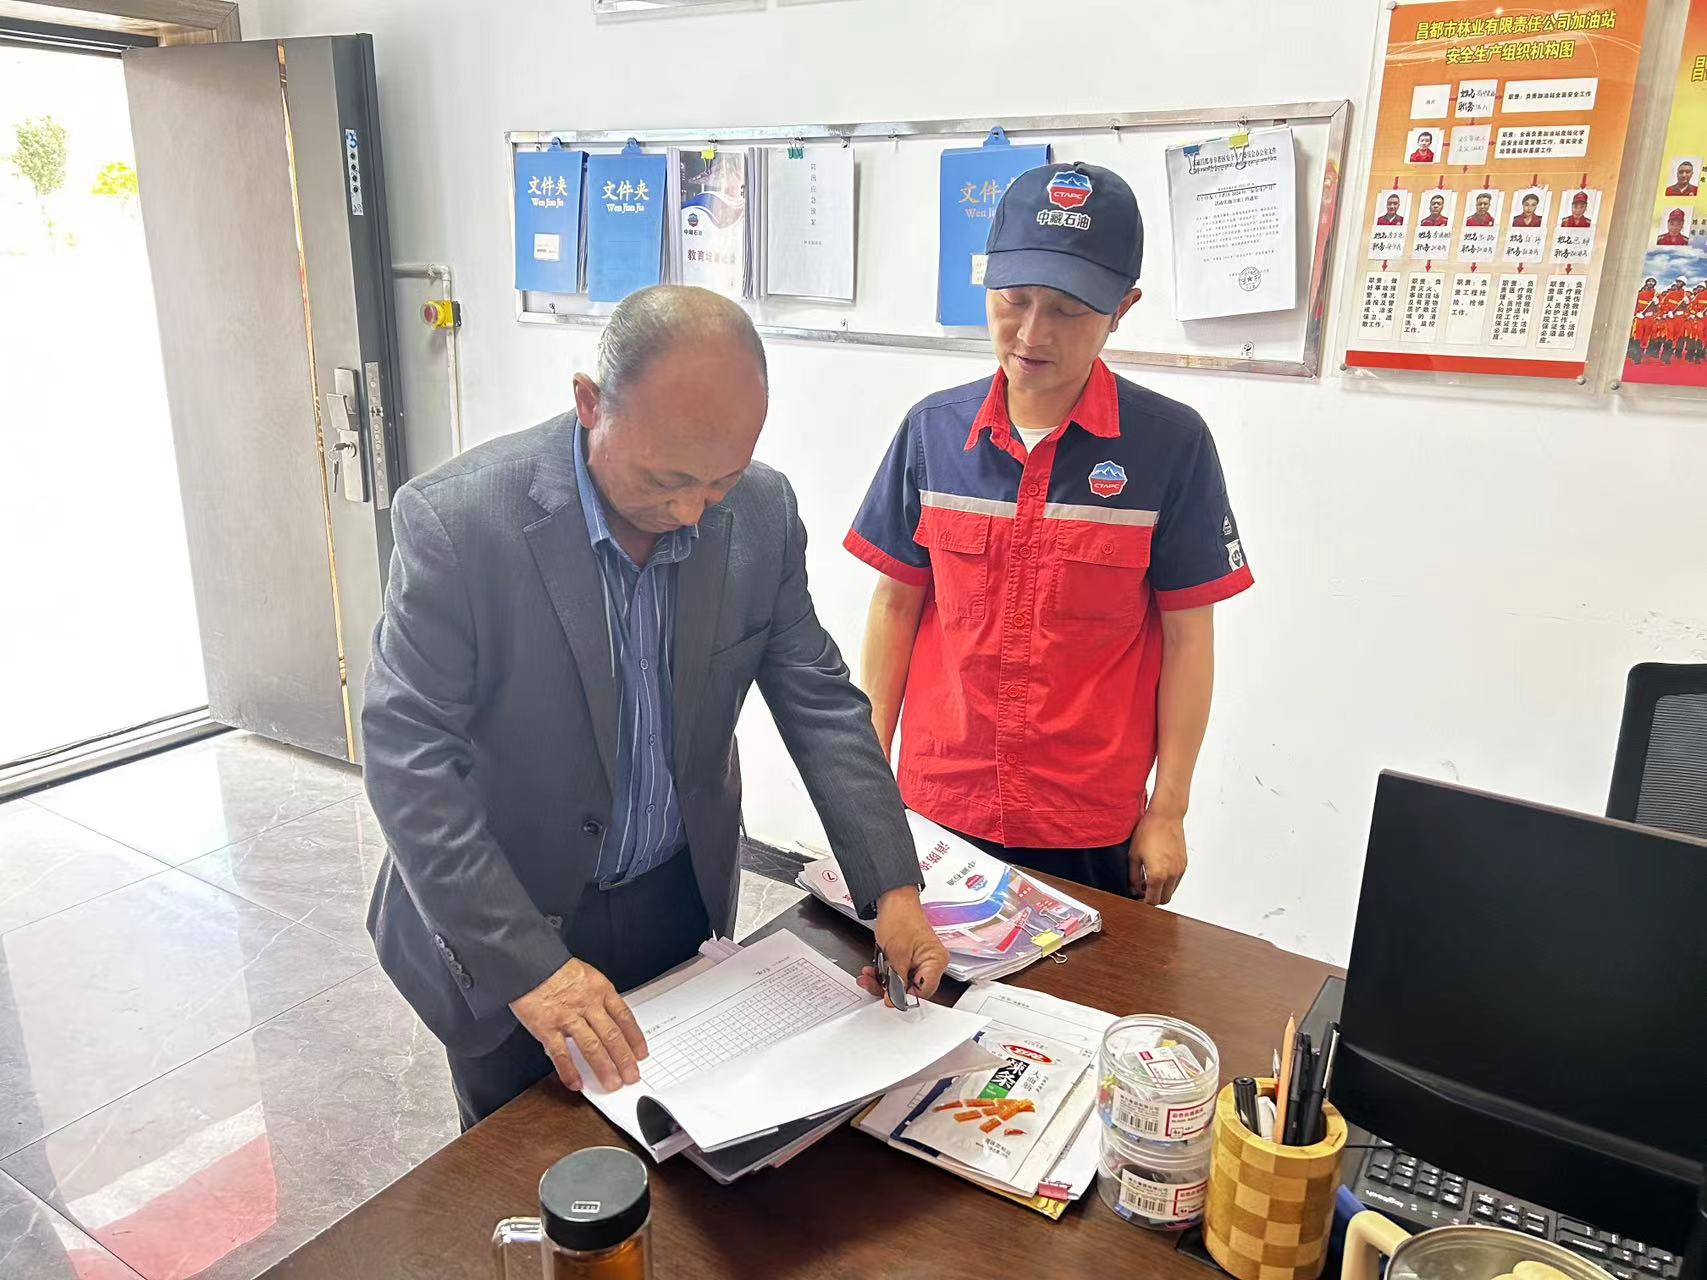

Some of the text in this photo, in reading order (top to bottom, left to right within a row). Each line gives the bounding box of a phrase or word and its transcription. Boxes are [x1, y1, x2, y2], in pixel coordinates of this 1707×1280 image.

[1415, 10, 1617, 41] 昌都市林业有限责任公司加油站
[1446, 41, 1575, 65] 安全生产组织机构图
[1691, 55, 1707, 82] 昌
[527, 176, 568, 196] 文件夹
[601, 179, 650, 202] 文件夹
[959, 178, 1016, 204] 文件
[1053, 191, 1083, 200] CTAPC
[606, 203, 621, 212] Wen
[1037, 210, 1091, 230] 中藏石油
[1094, 482, 1121, 490] CTAPC
[919, 841, 950, 872] 消防设
